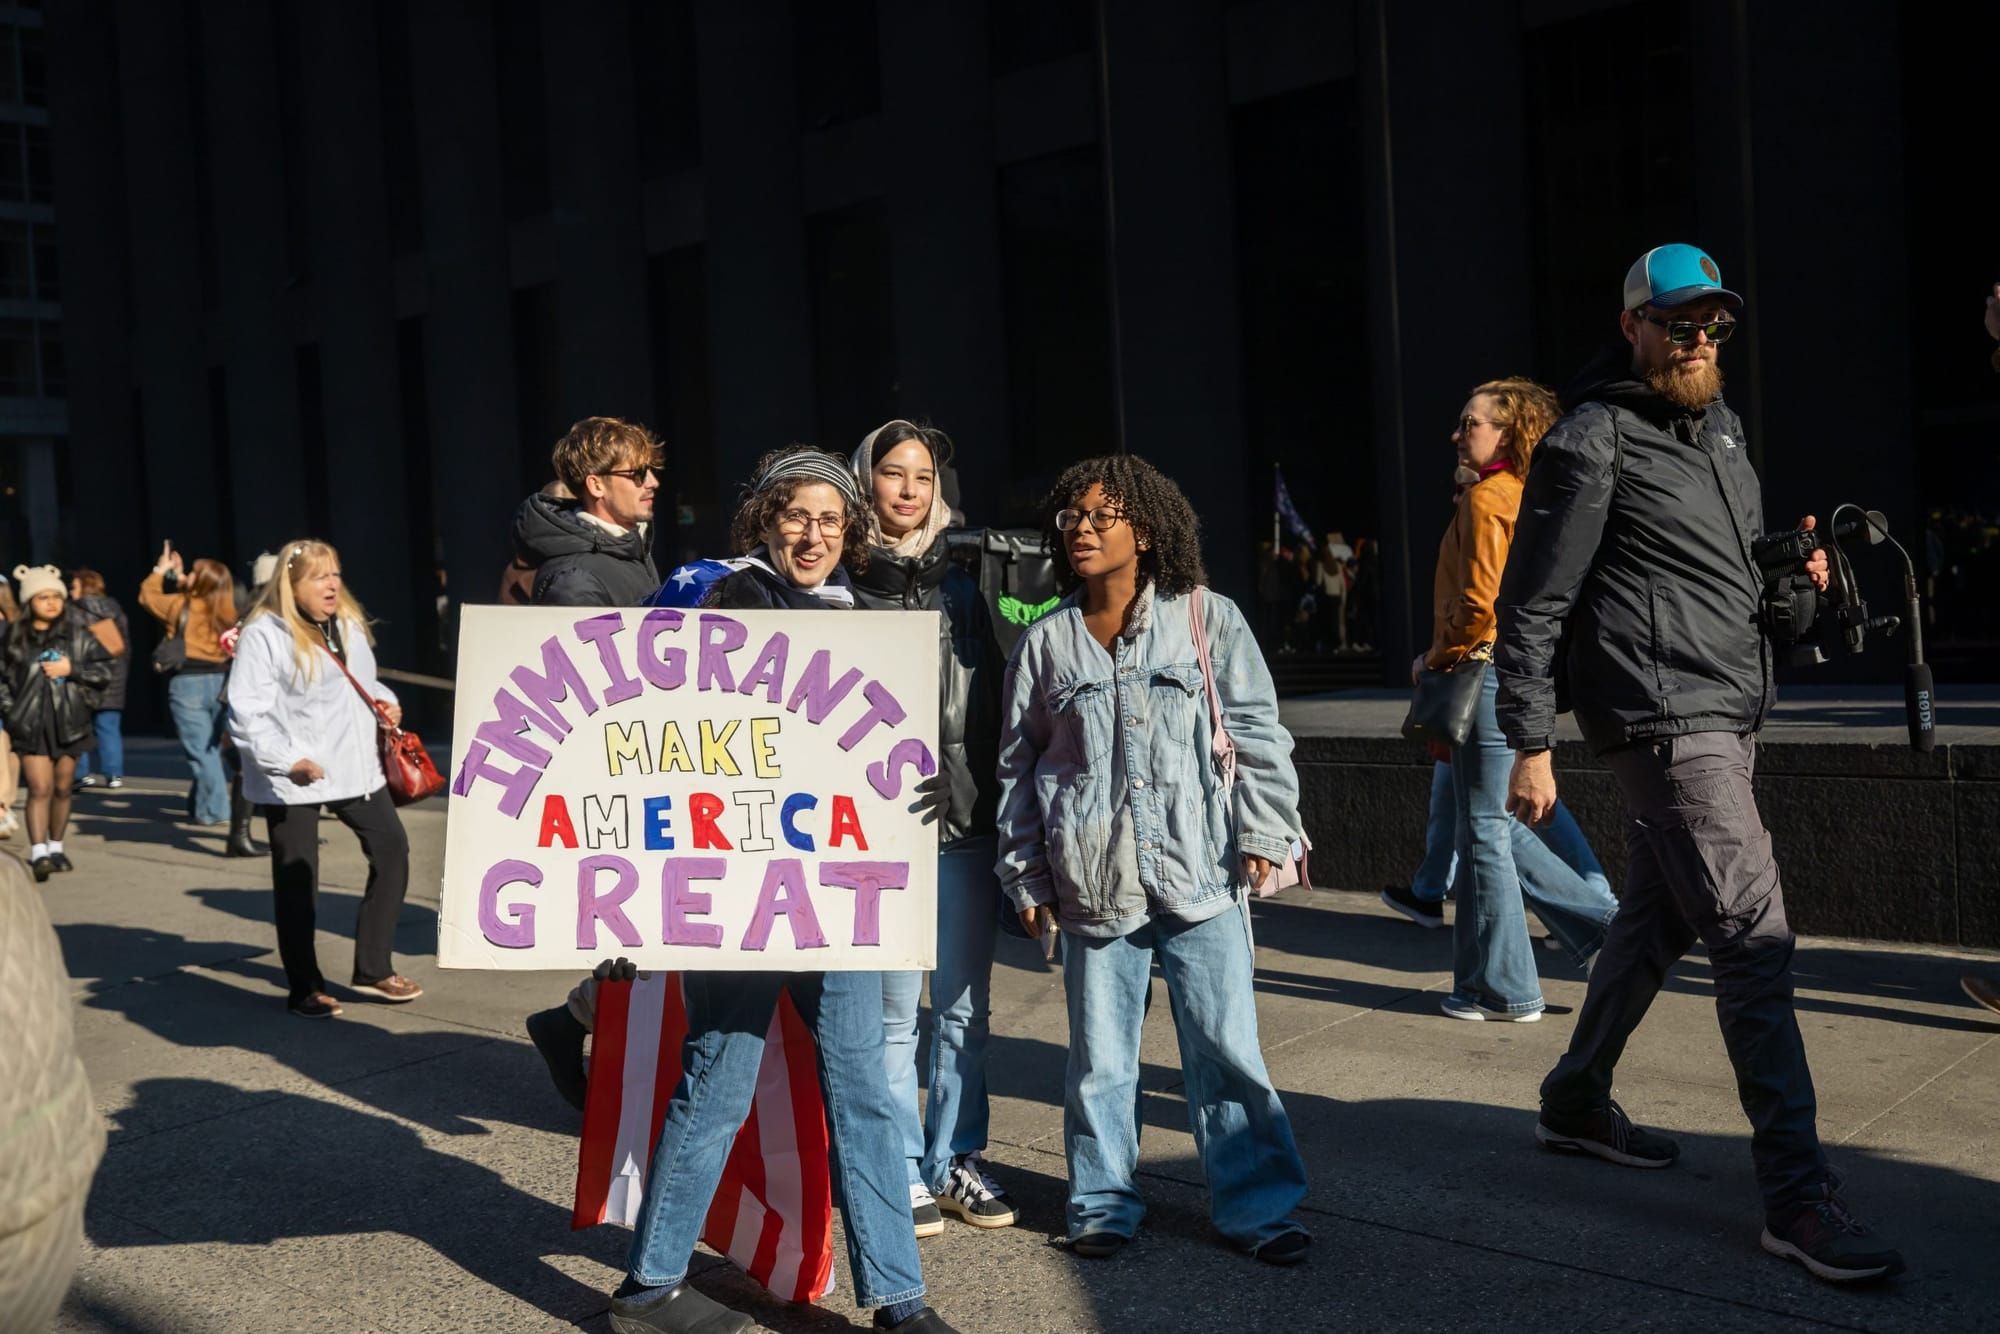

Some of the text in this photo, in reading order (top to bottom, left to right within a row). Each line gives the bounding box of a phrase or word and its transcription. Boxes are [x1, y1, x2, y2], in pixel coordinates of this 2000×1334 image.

[452, 608, 937, 820] IMMIGRANTS
[604, 717, 782, 779] MAKE
[537, 790, 869, 852] AMERICA
[477, 854, 910, 952] GREAT
